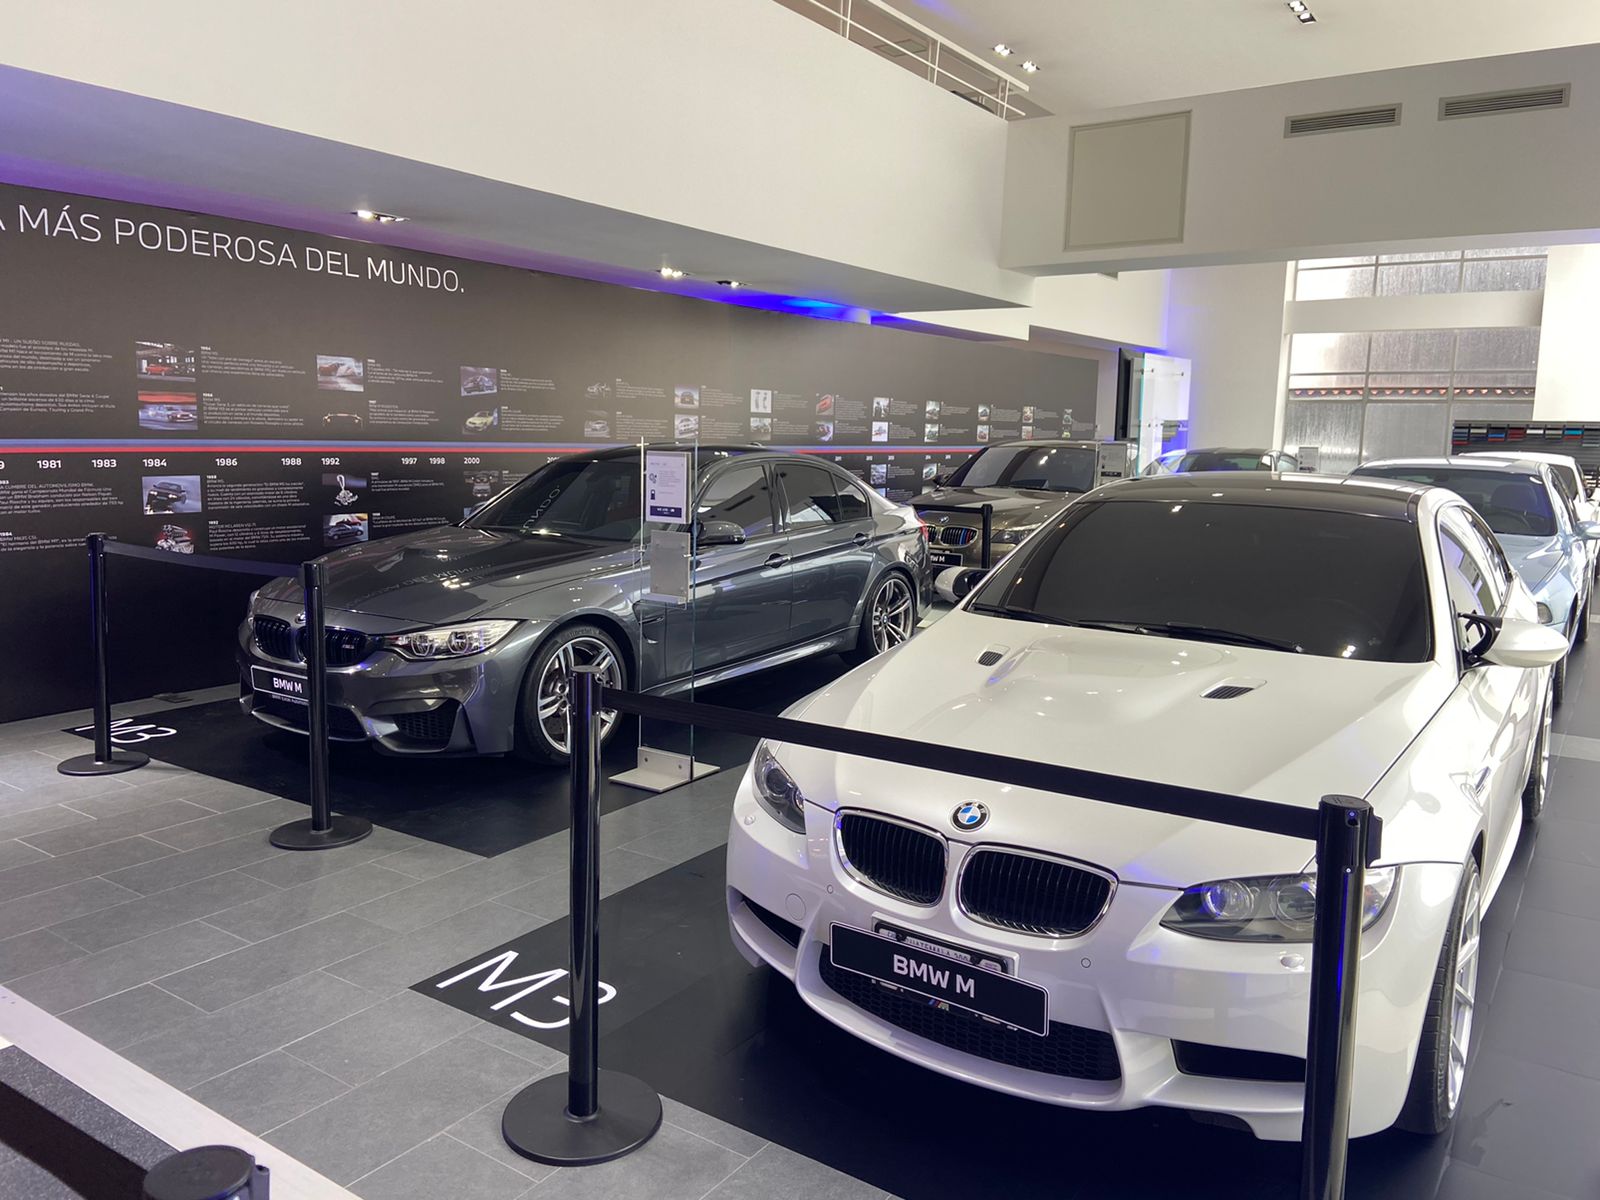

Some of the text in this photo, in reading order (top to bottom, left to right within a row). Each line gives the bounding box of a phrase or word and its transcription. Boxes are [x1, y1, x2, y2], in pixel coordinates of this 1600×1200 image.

[19, 205, 102, 242] MÁS
[114, 218, 297, 269] PODEROSA
[306, 247, 360, 278] DEL
[367, 257, 466, 293] MUNDO.
[37, 460, 62, 469] 1981
[92, 459, 117, 468] 1983
[142, 458, 167, 467] 1984
[215, 458, 238, 466] 1986
[281, 458, 302, 466] 1988
[321, 458, 340, 466] 1992
[272, 677, 302, 694] BMW M
[74, 718, 178, 744] M3
[435, 950, 618, 1029] M3
[893, 954, 975, 998] BMW M
